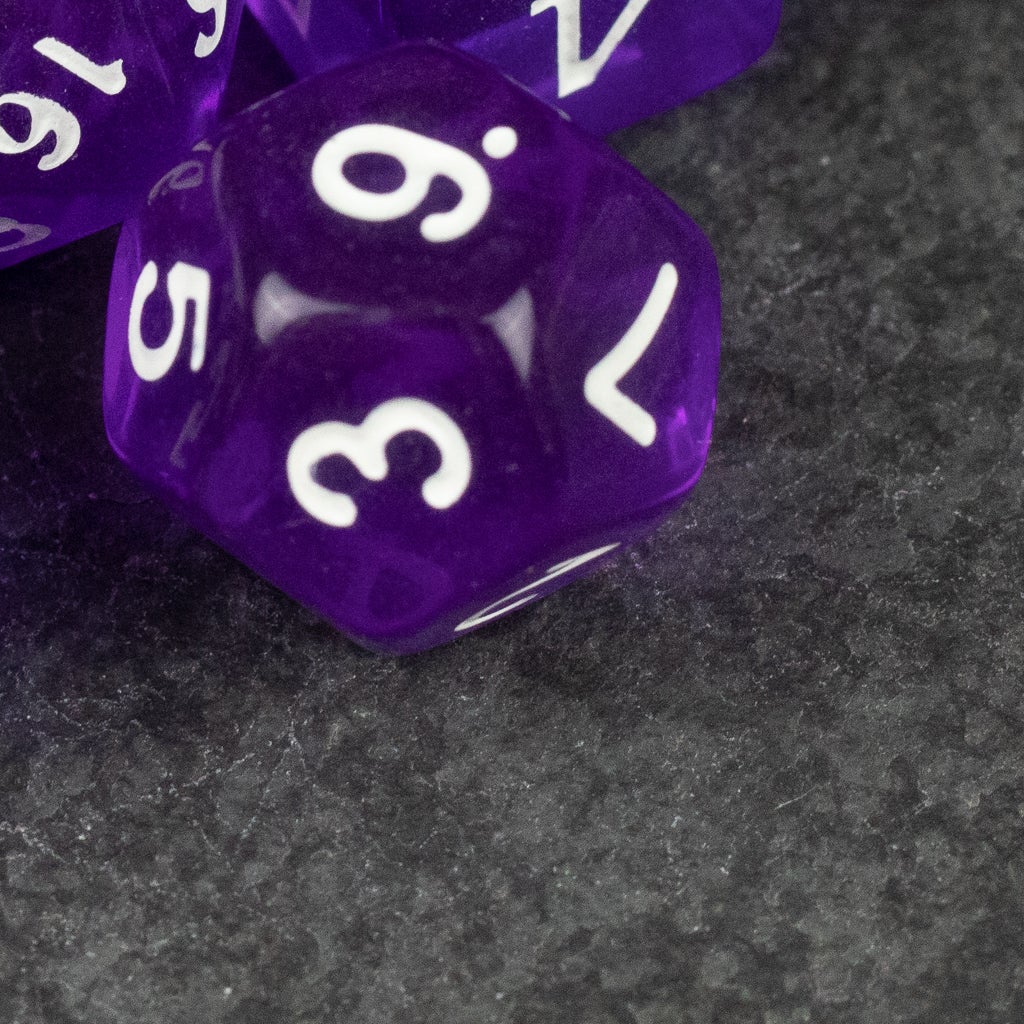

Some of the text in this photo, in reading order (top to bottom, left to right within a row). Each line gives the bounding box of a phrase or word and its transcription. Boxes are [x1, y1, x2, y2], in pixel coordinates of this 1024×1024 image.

[127, 260, 210, 382] 5
[584, 262, 679, 447] 7
[286, 397, 472, 528] 3
